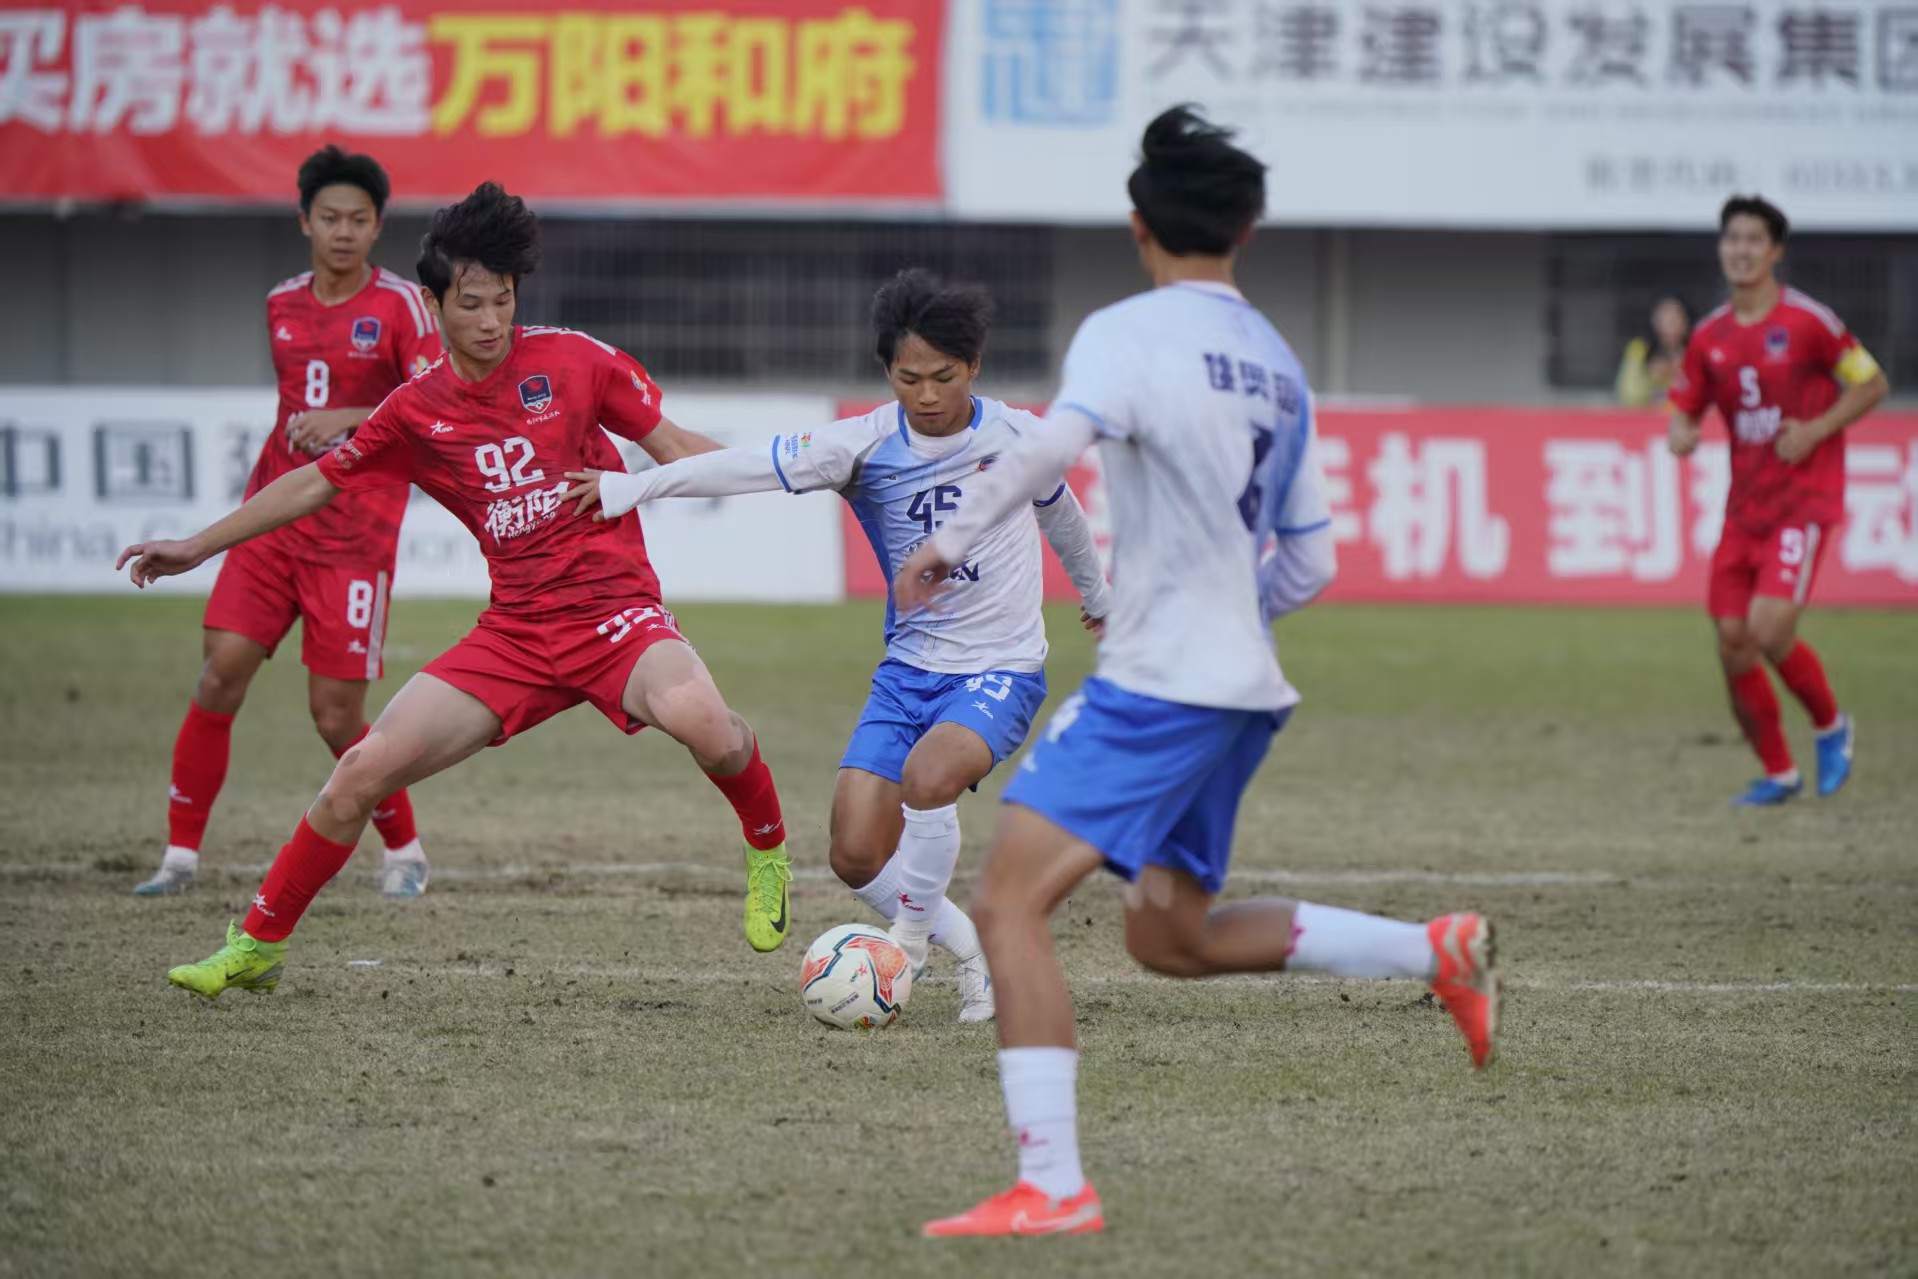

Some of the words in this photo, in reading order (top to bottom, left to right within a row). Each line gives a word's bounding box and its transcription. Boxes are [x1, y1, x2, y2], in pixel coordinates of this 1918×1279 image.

[304, 359, 330, 408] 8
[1738, 364, 1762, 408] 5
[474, 436, 546, 493] 92
[507, 510, 557, 540] Hengyang
[1779, 527, 1804, 566] 5
[347, 579, 374, 629] 8
